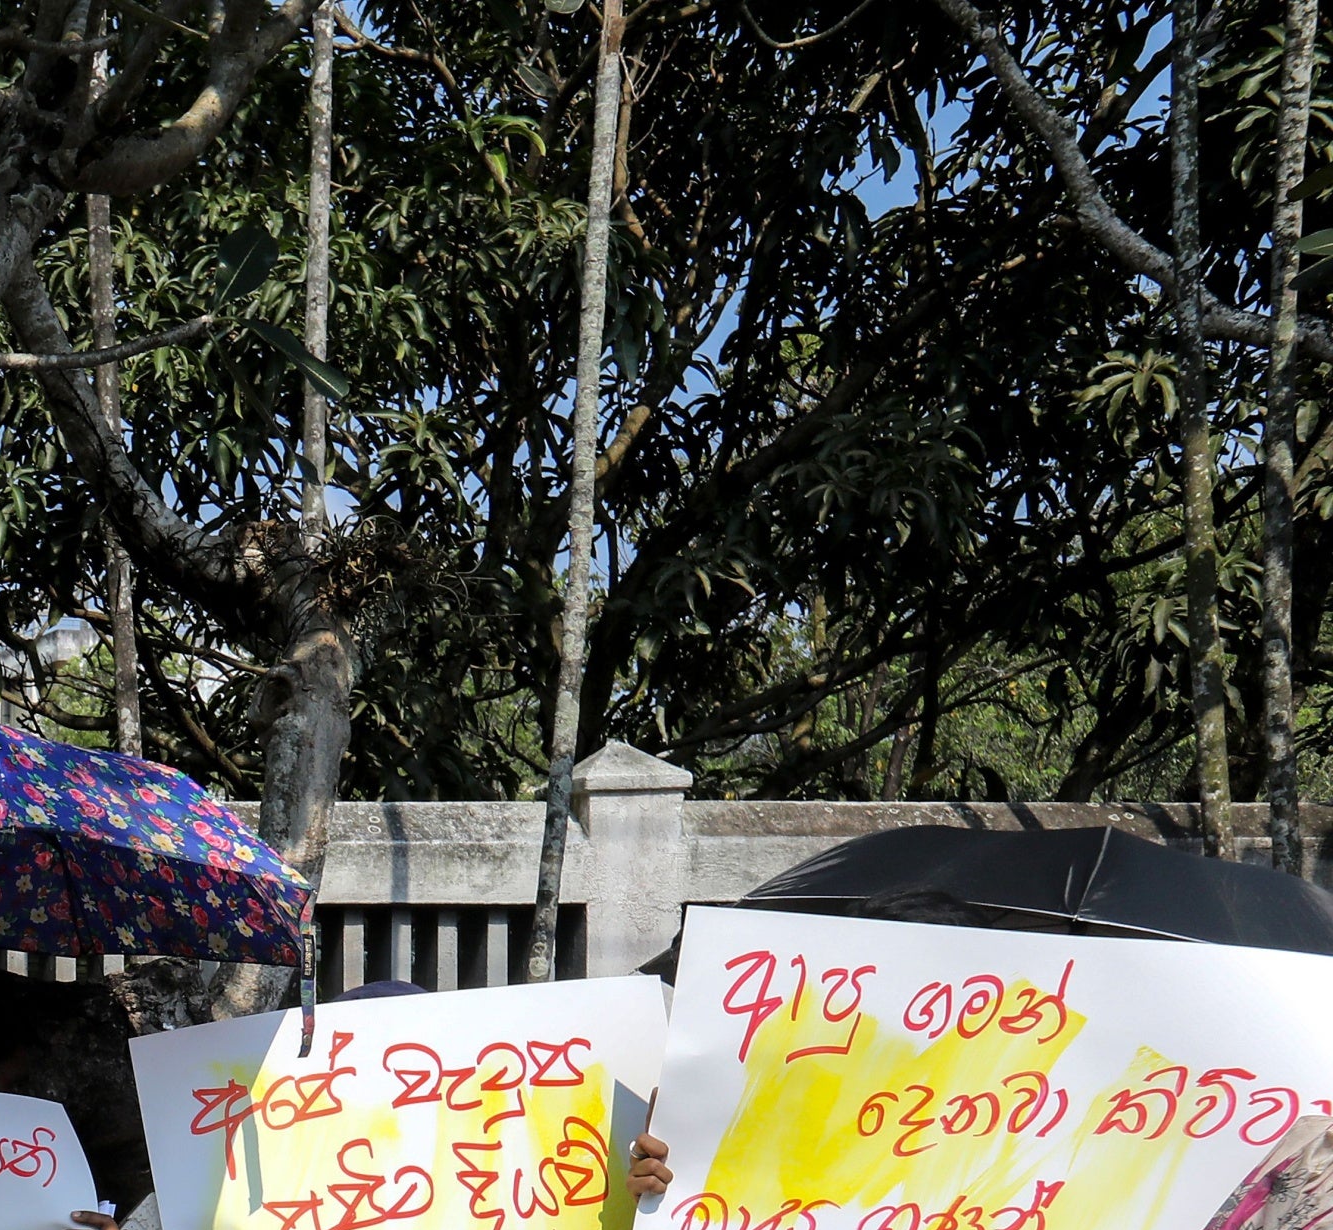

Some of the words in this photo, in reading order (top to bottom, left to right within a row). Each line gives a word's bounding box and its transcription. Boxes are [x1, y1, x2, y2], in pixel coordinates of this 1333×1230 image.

[722, 950, 877, 1064] ආපු
[903, 958, 1074, 1044] ගමන්
[858, 1071, 1069, 1157] දෙනවා
